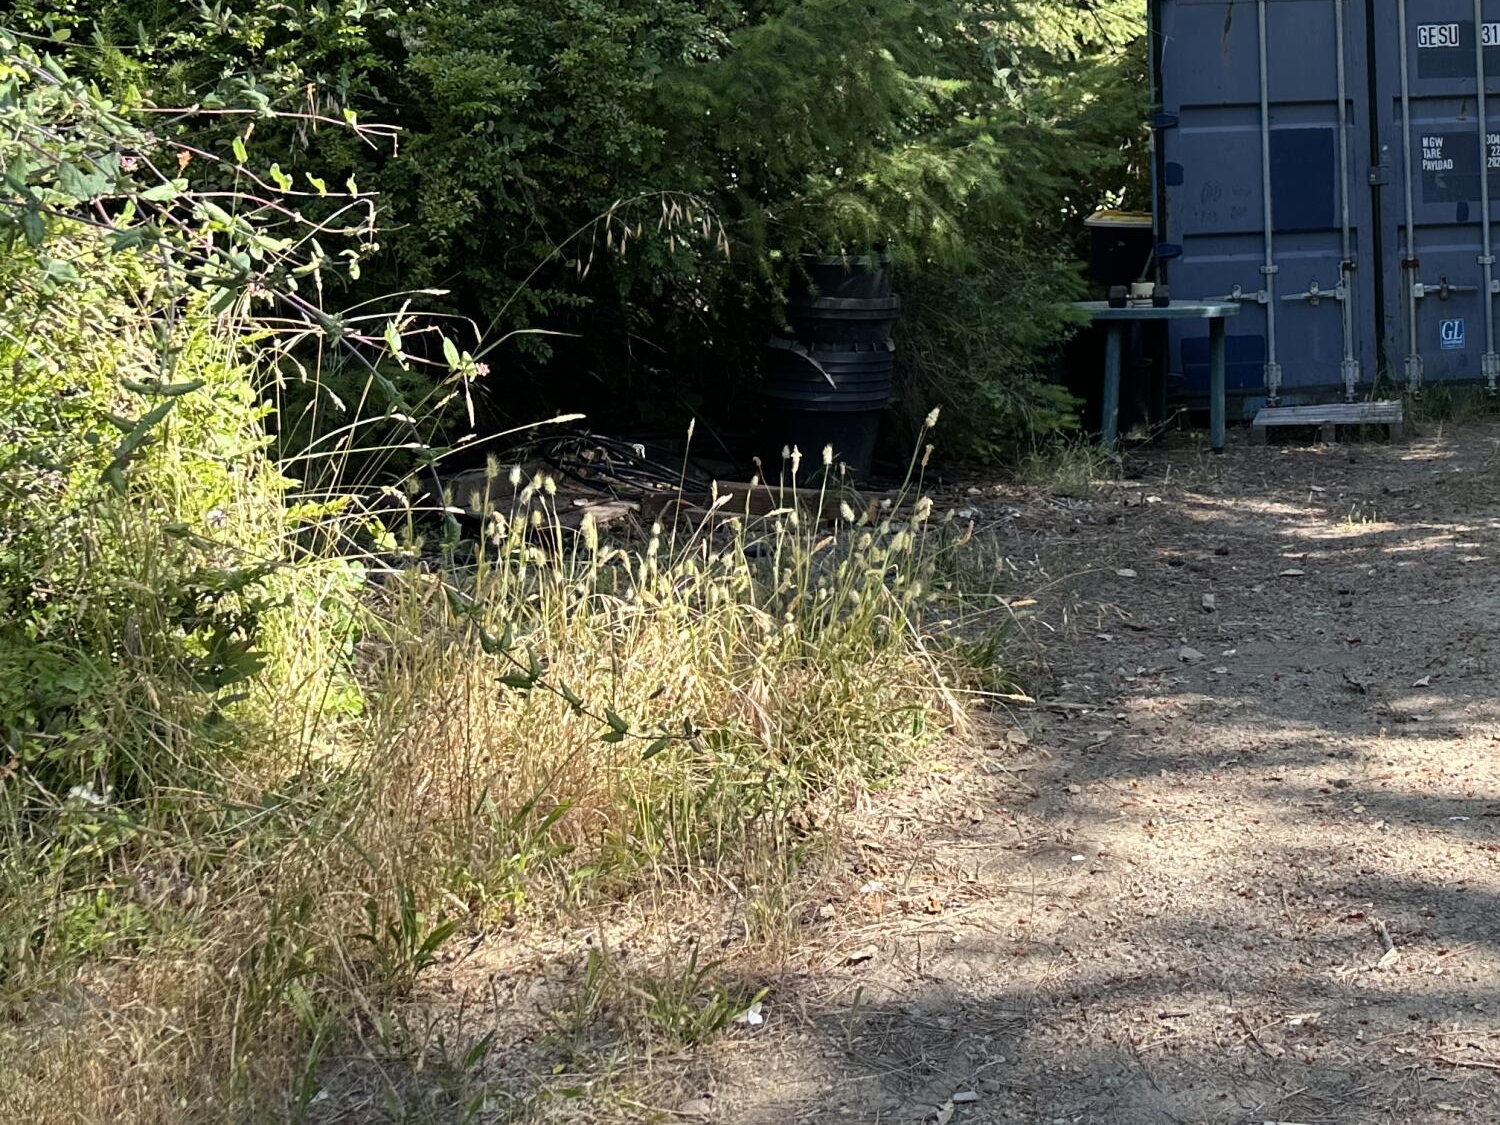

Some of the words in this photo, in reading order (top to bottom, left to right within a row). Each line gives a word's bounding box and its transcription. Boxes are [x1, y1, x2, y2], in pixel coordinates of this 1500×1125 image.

[1418, 25, 1458, 46] GESU
[1422, 148, 1442, 159] TARE
[1422, 159, 1453, 171] PAYLOAD
[1441, 321, 1463, 340] GL
